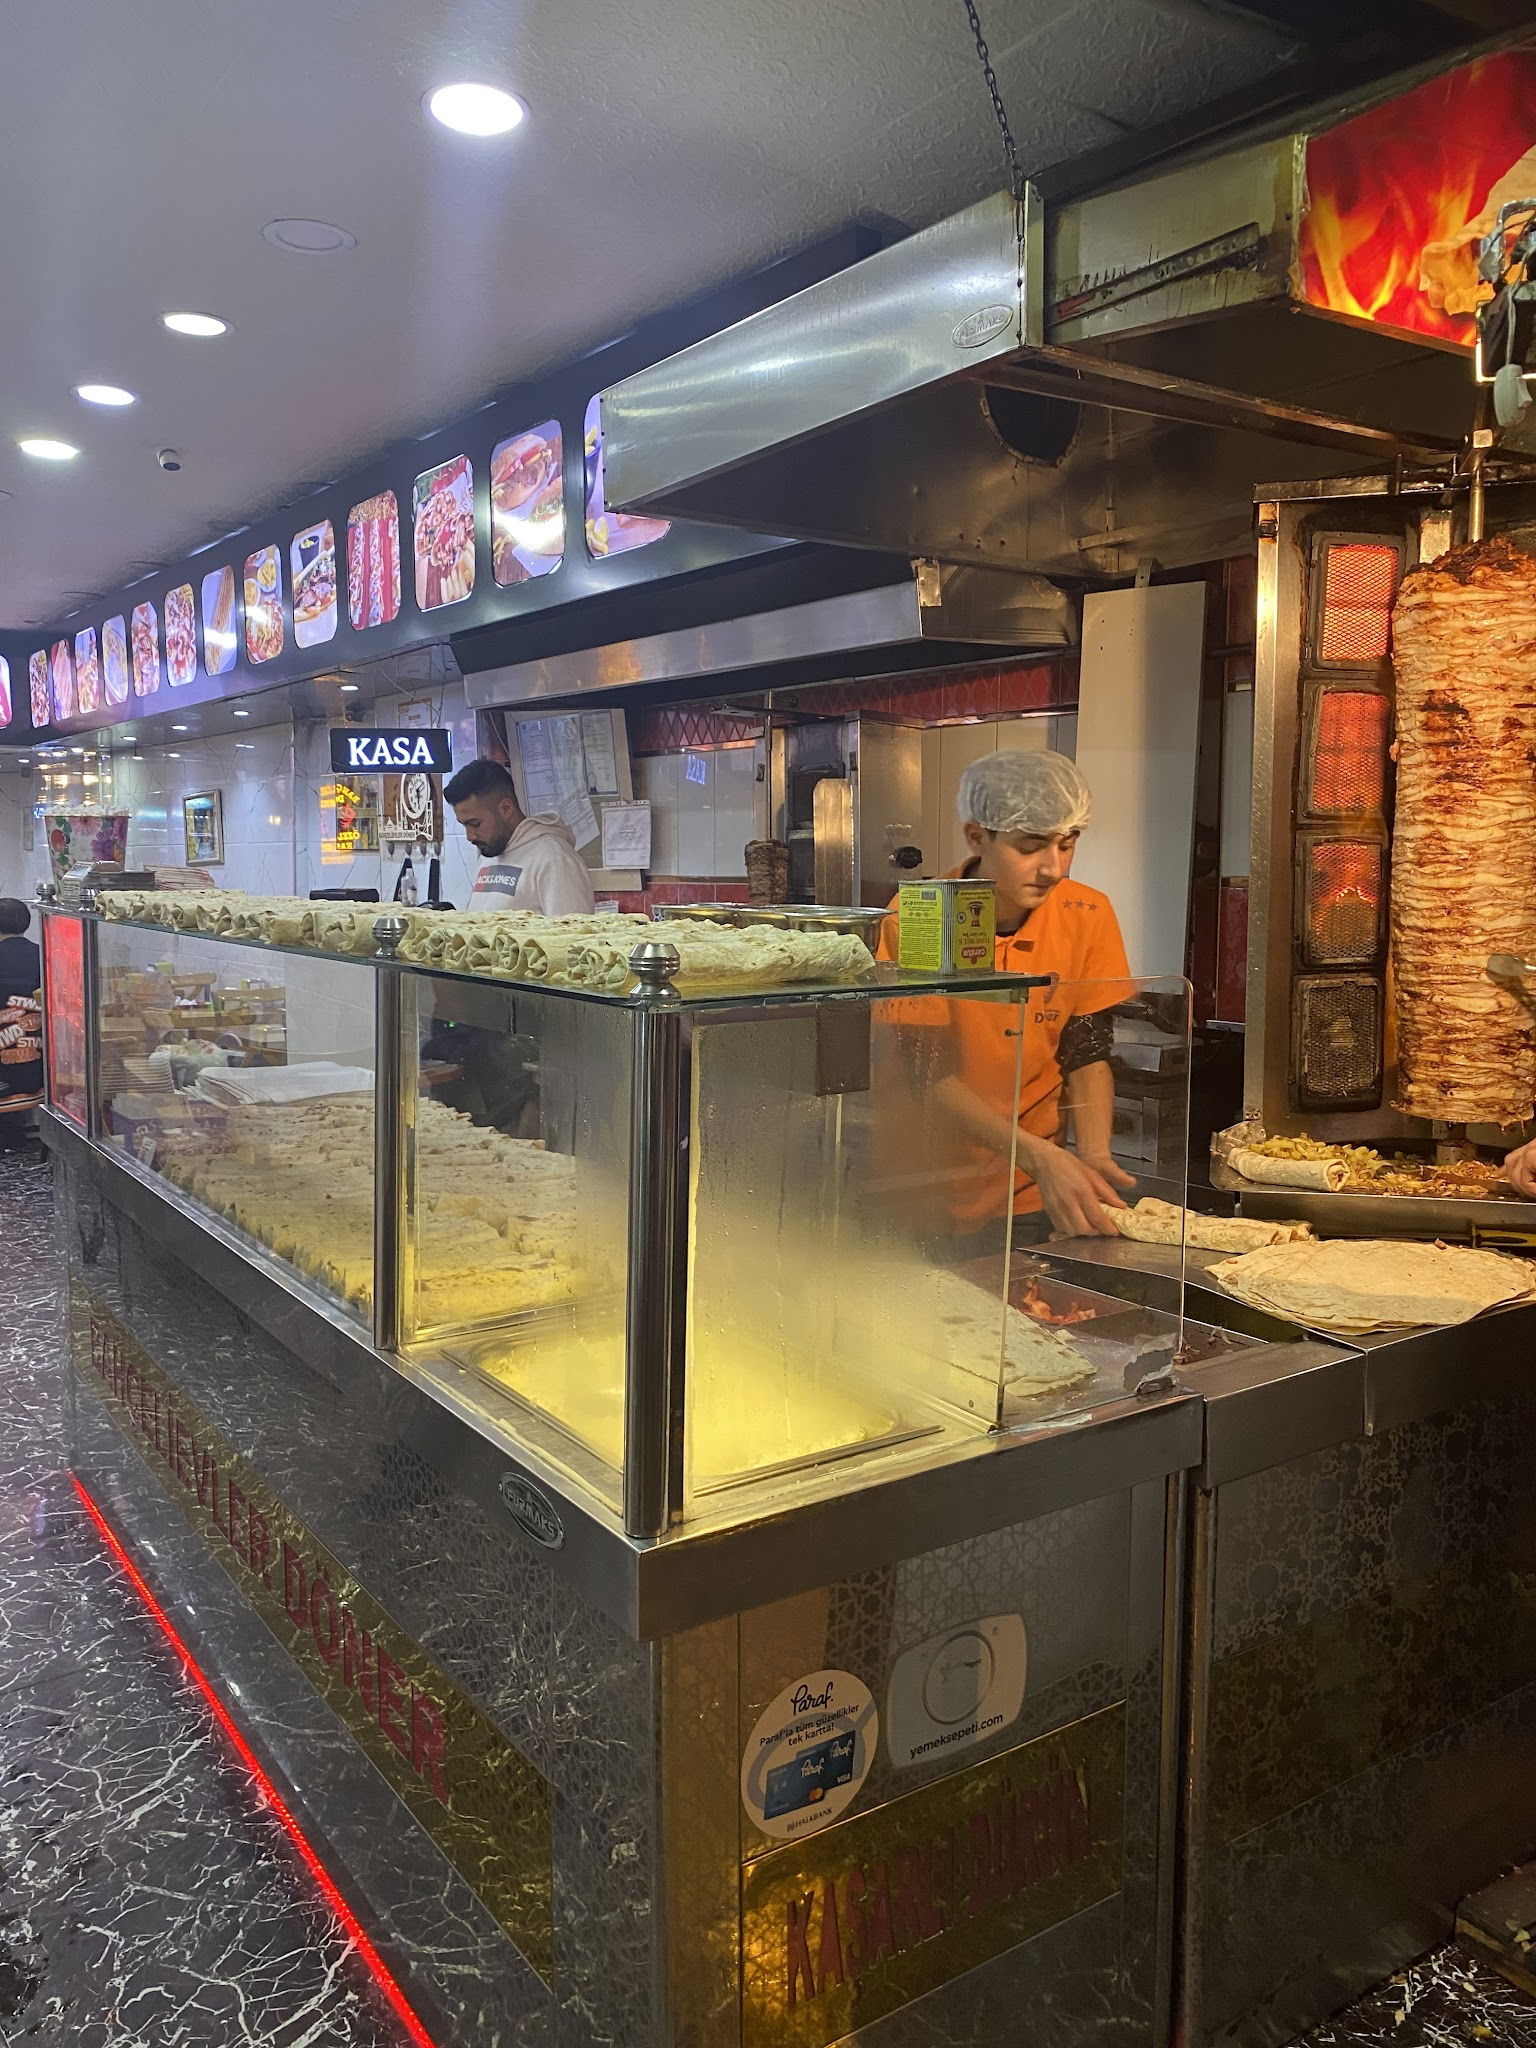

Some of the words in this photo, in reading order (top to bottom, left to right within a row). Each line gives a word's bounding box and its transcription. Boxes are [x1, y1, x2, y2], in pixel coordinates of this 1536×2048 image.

[347, 736, 435, 766] KASA
[283, 1540, 450, 1804] DÖNER
[788, 1735, 804, 1747] tek
[804, 1723, 835, 1743] kartta!
[795, 1720, 814, 1736] tüm
[815, 1703, 860, 1729] güzellikler
[909, 1712, 1004, 1760] yemeksepeti.com
